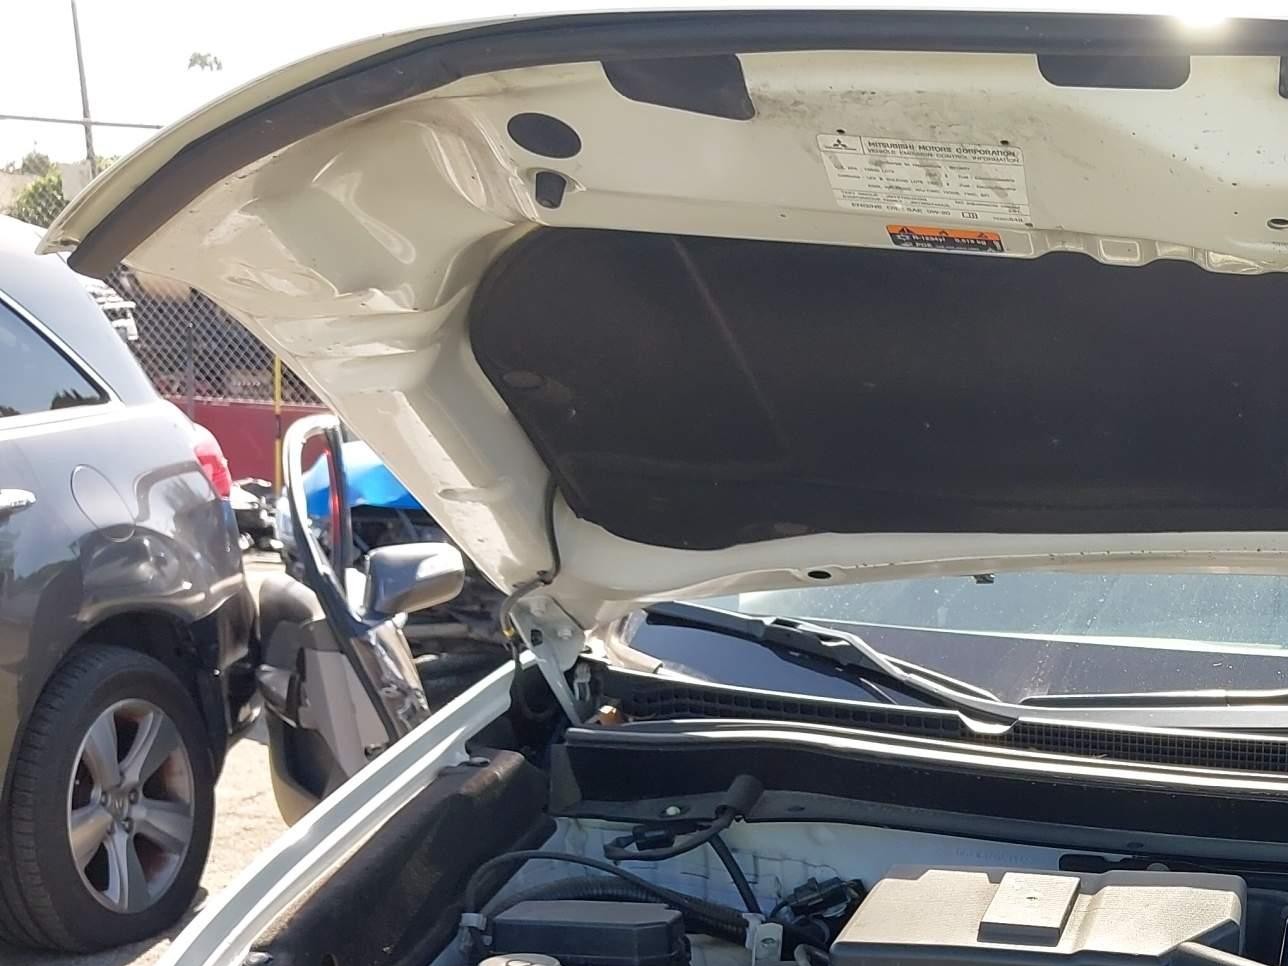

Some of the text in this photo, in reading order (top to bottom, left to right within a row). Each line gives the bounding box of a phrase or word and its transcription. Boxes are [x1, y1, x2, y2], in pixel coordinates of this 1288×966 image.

[867, 140, 1016, 158] MITSUBISHI MOTORS CORPORATION
